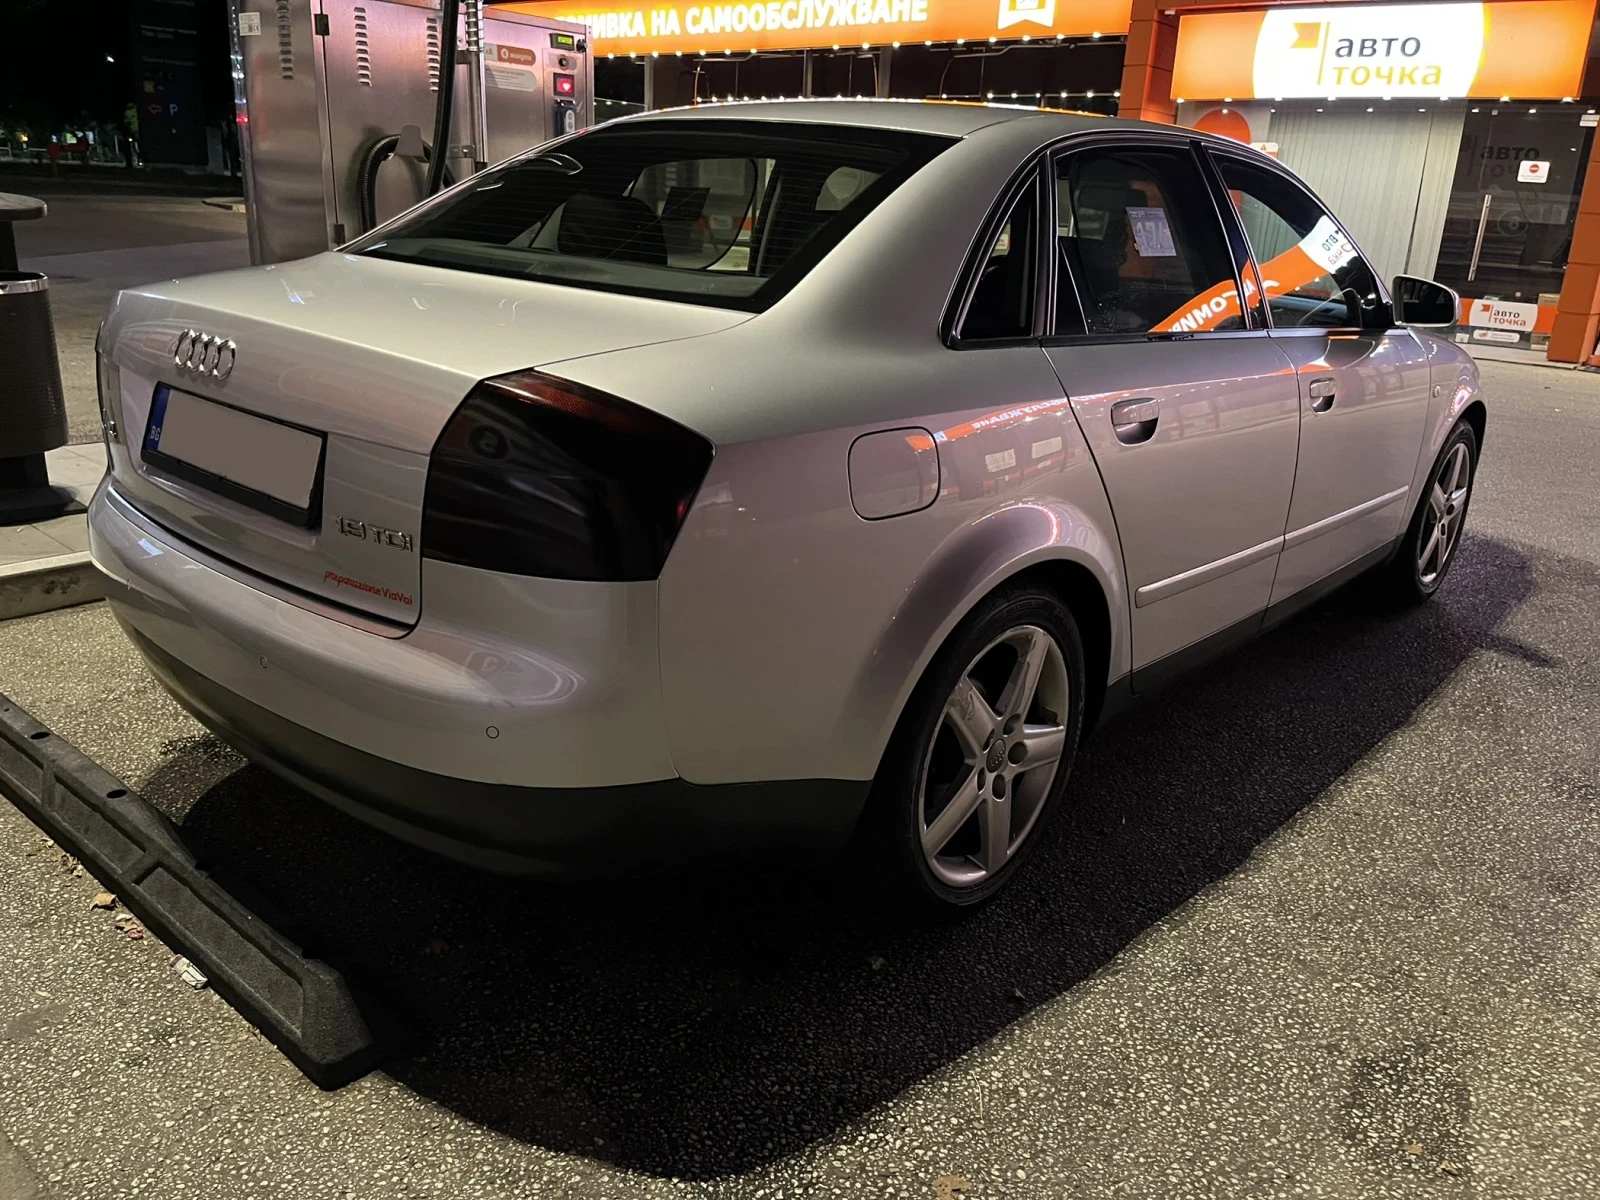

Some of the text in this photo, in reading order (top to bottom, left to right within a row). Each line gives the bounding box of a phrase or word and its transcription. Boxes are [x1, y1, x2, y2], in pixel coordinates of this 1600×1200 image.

[651, 8, 681, 36] НА
[685, 0, 928, 35] САМООБСЛУЖВАНЕ
[1334, 36, 1421, 58] авто
[1332, 65, 1442, 86] точка
[1480, 145, 1540, 161] авто
[1493, 309, 1521, 319] авто
[1493, 317, 1527, 327] точка
[150, 425, 161, 442] BG
[368, 523, 414, 553] TDI
